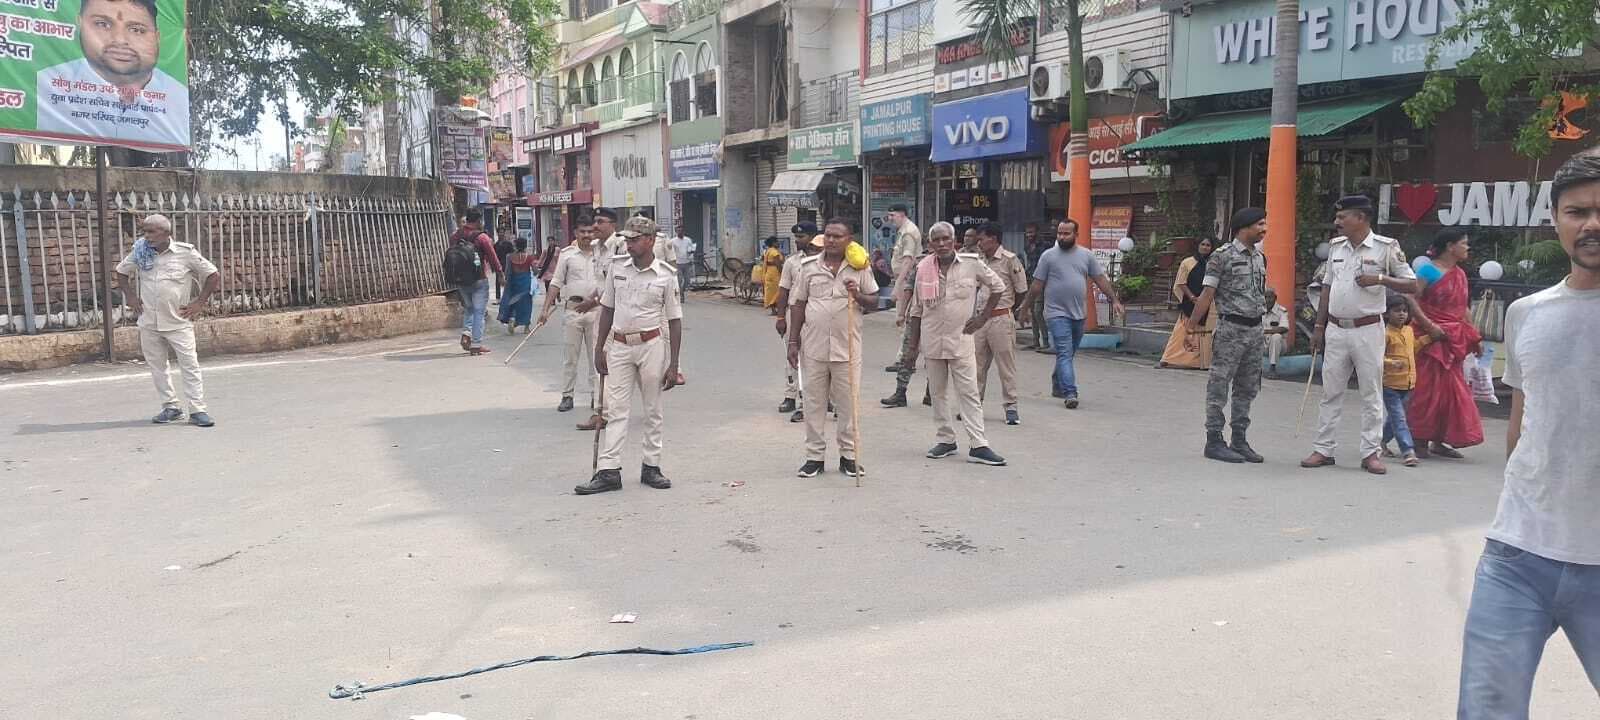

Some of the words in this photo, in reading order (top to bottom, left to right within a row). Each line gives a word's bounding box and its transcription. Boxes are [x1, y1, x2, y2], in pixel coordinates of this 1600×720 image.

[10, 16, 30, 31] का
[33, 19, 74, 38] आभार
[1213, 7, 1332, 65] WHIE
[870, 100, 913, 120] JAMALPUR
[863, 121, 895, 138] PRINTING
[896, 116, 921, 134] HOUSE
[1089, 148, 1120, 165] CICI
[972, 195, 991, 208] 0%
[1437, 181, 1557, 227] JAMA
